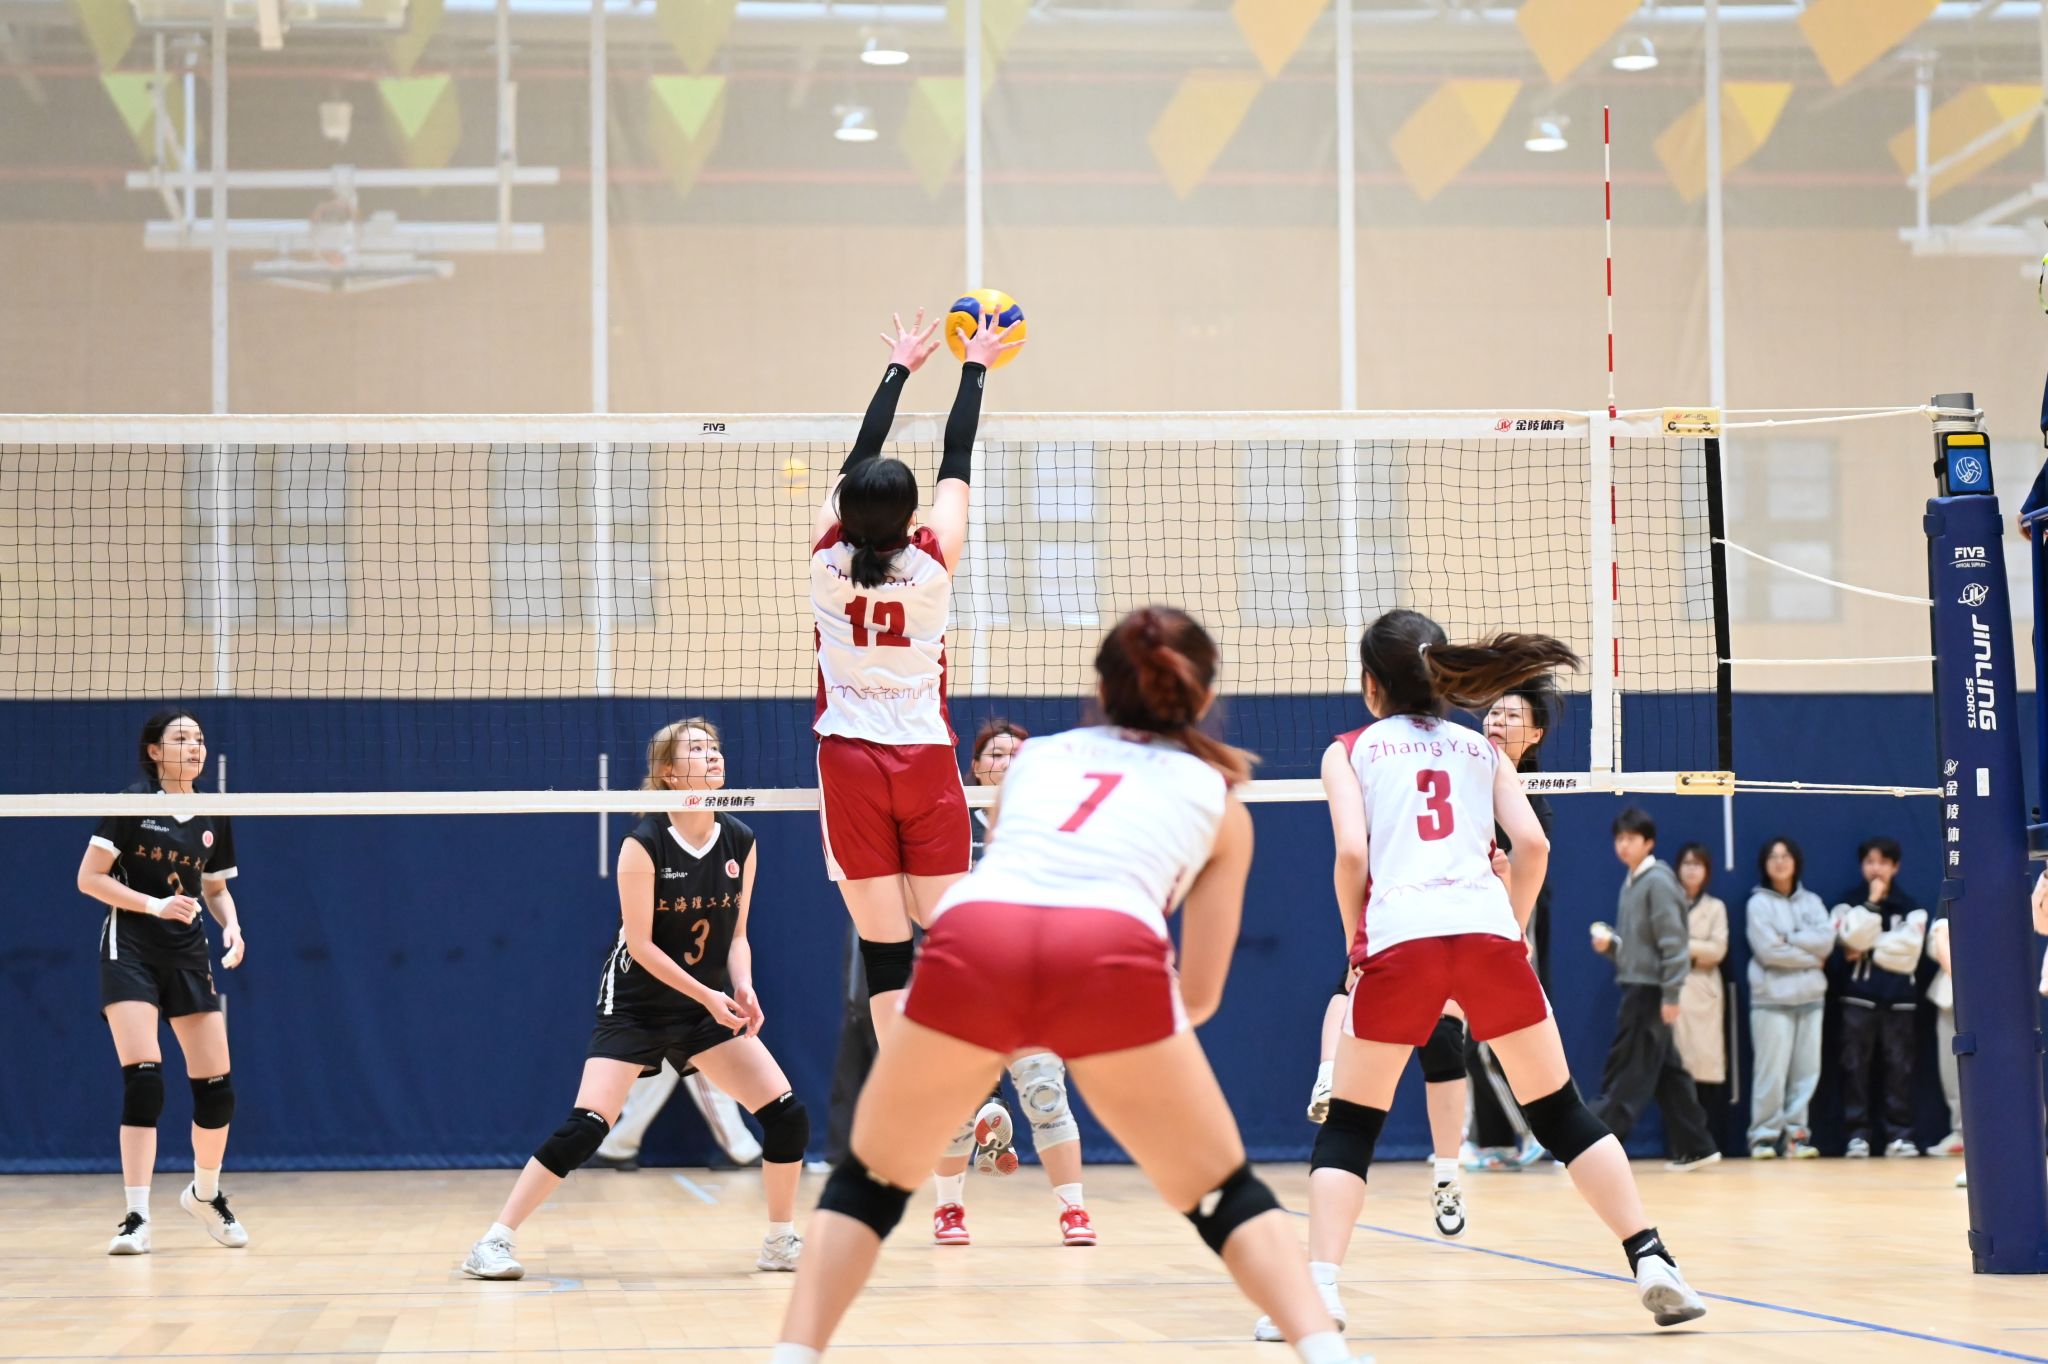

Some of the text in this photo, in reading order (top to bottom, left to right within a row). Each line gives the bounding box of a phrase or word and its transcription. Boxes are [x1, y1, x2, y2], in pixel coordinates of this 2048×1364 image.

[703, 422, 726, 432] FIVB
[1515, 419, 1565, 431] 金陵体育
[1954, 546, 1985, 559] FIVB
[844, 595, 911, 647] 12
[1971, 613, 1997, 731] JINLING
[1965, 677, 1977, 729] SPORTS
[704, 796, 755, 807] 金陵体育
[1057, 772, 1124, 832] 7
[1416, 768, 1455, 842] 3
[1527, 778, 1577, 790] 金陵体育
[1946, 780, 1960, 866] 金陵体育
[683, 918, 711, 967] 3
